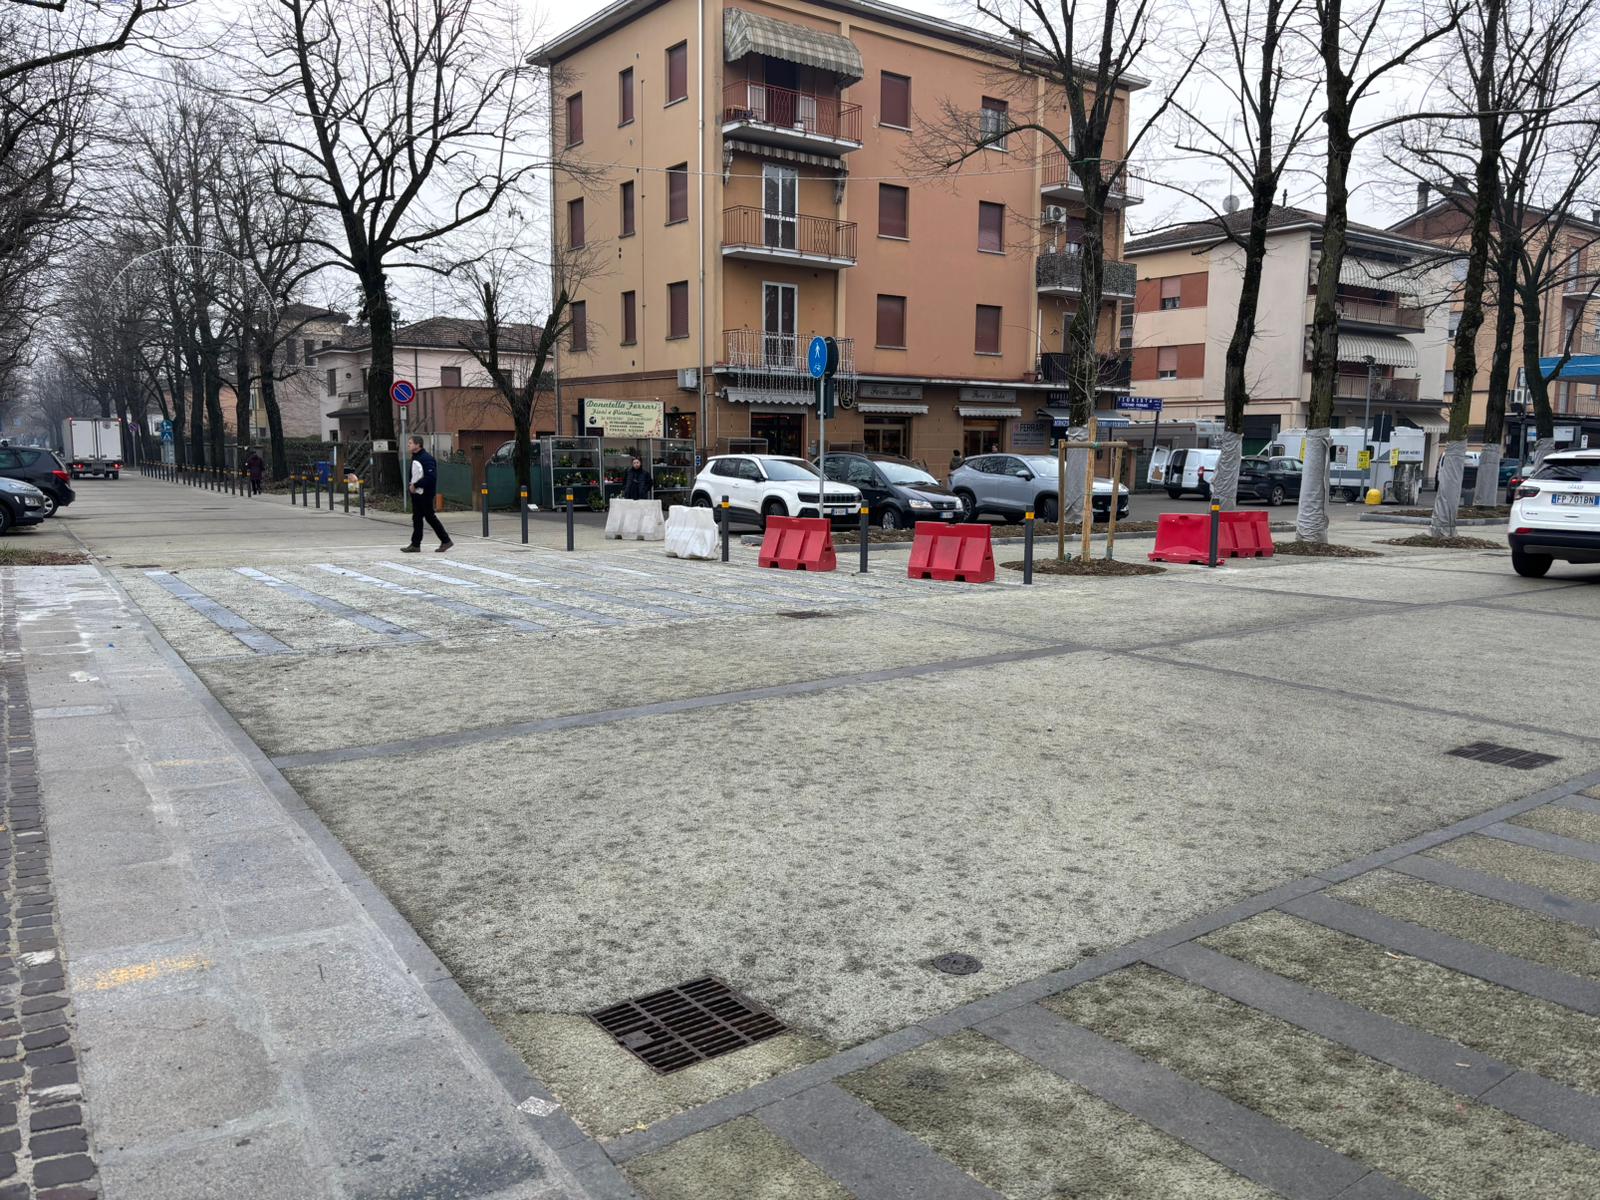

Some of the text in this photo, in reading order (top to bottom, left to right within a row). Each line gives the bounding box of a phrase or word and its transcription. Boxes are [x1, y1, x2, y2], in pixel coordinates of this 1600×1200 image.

[586, 400, 657, 410] Donatella Ferrari
[1557, 494, 1594, 504] FP 701BN
